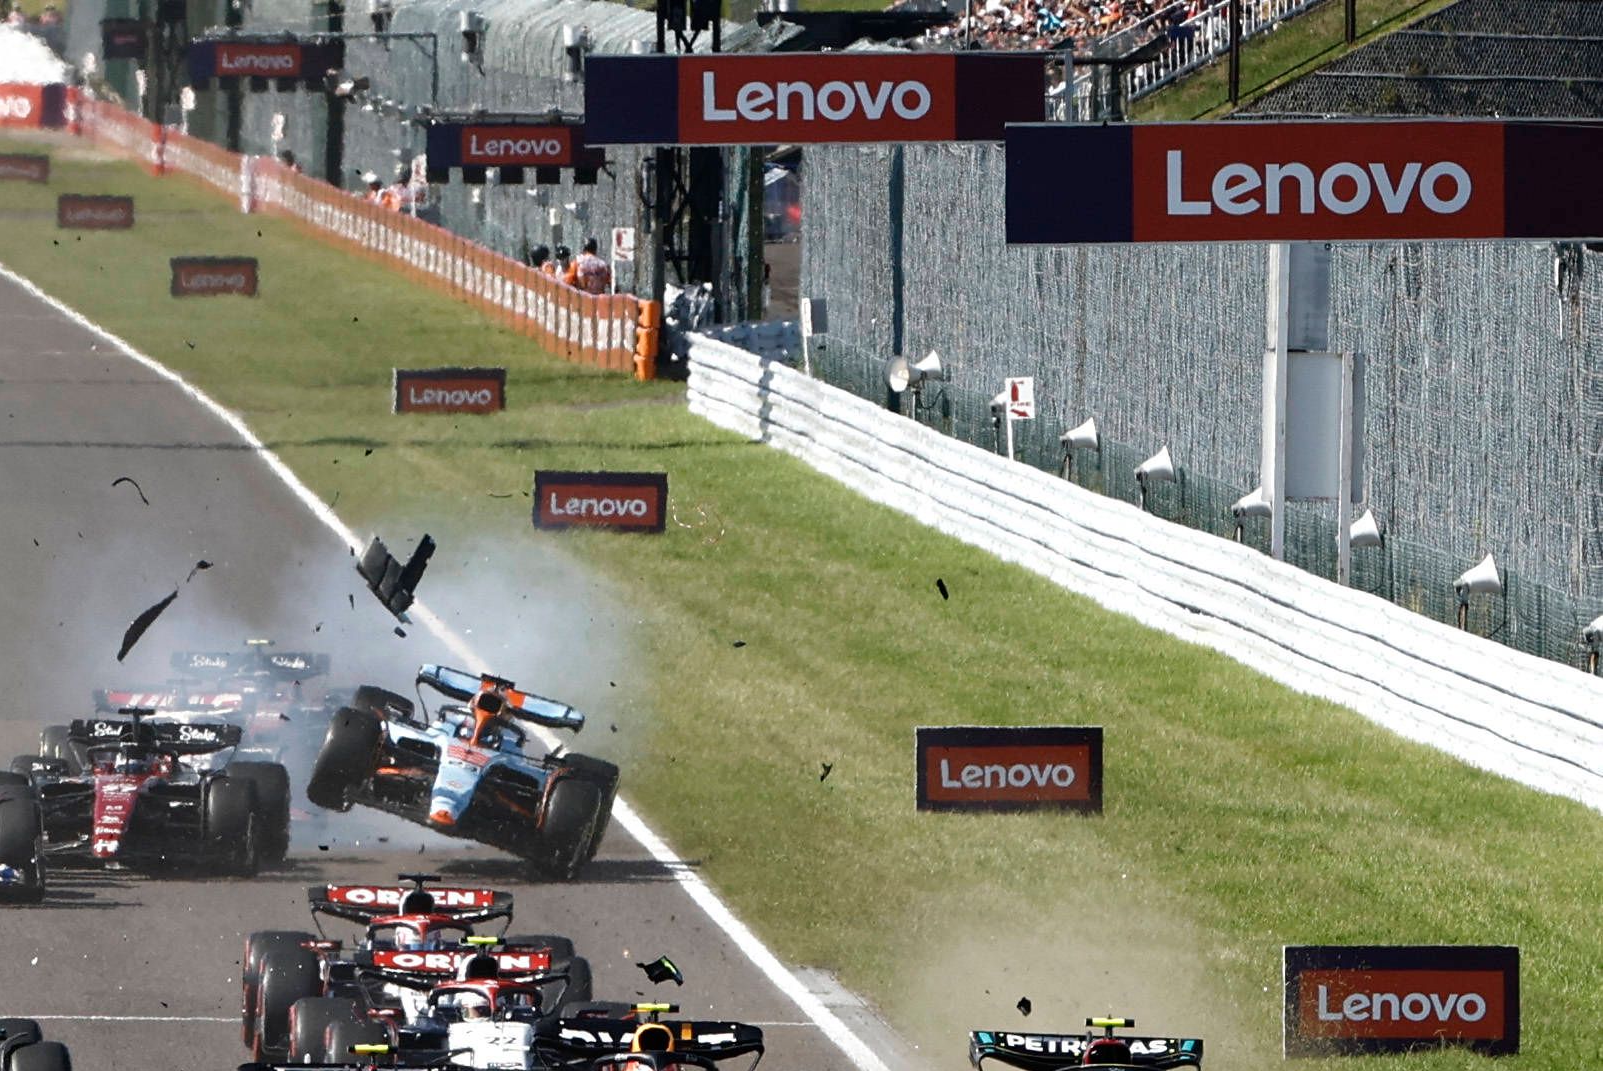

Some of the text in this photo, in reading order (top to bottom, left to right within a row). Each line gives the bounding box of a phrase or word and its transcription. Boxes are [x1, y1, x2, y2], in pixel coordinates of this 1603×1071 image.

[222, 51, 294, 69] Lenovo
[703, 72, 931, 121] Lenovo
[470, 135, 561, 157] Lenovo
[1166, 150, 1473, 216] Lenovo
[410, 387, 492, 405] Lenovo
[550, 492, 648, 517] Lenovo
[941, 758, 1075, 790] Lenovo
[1317, 987, 1487, 1023] Lenovo
